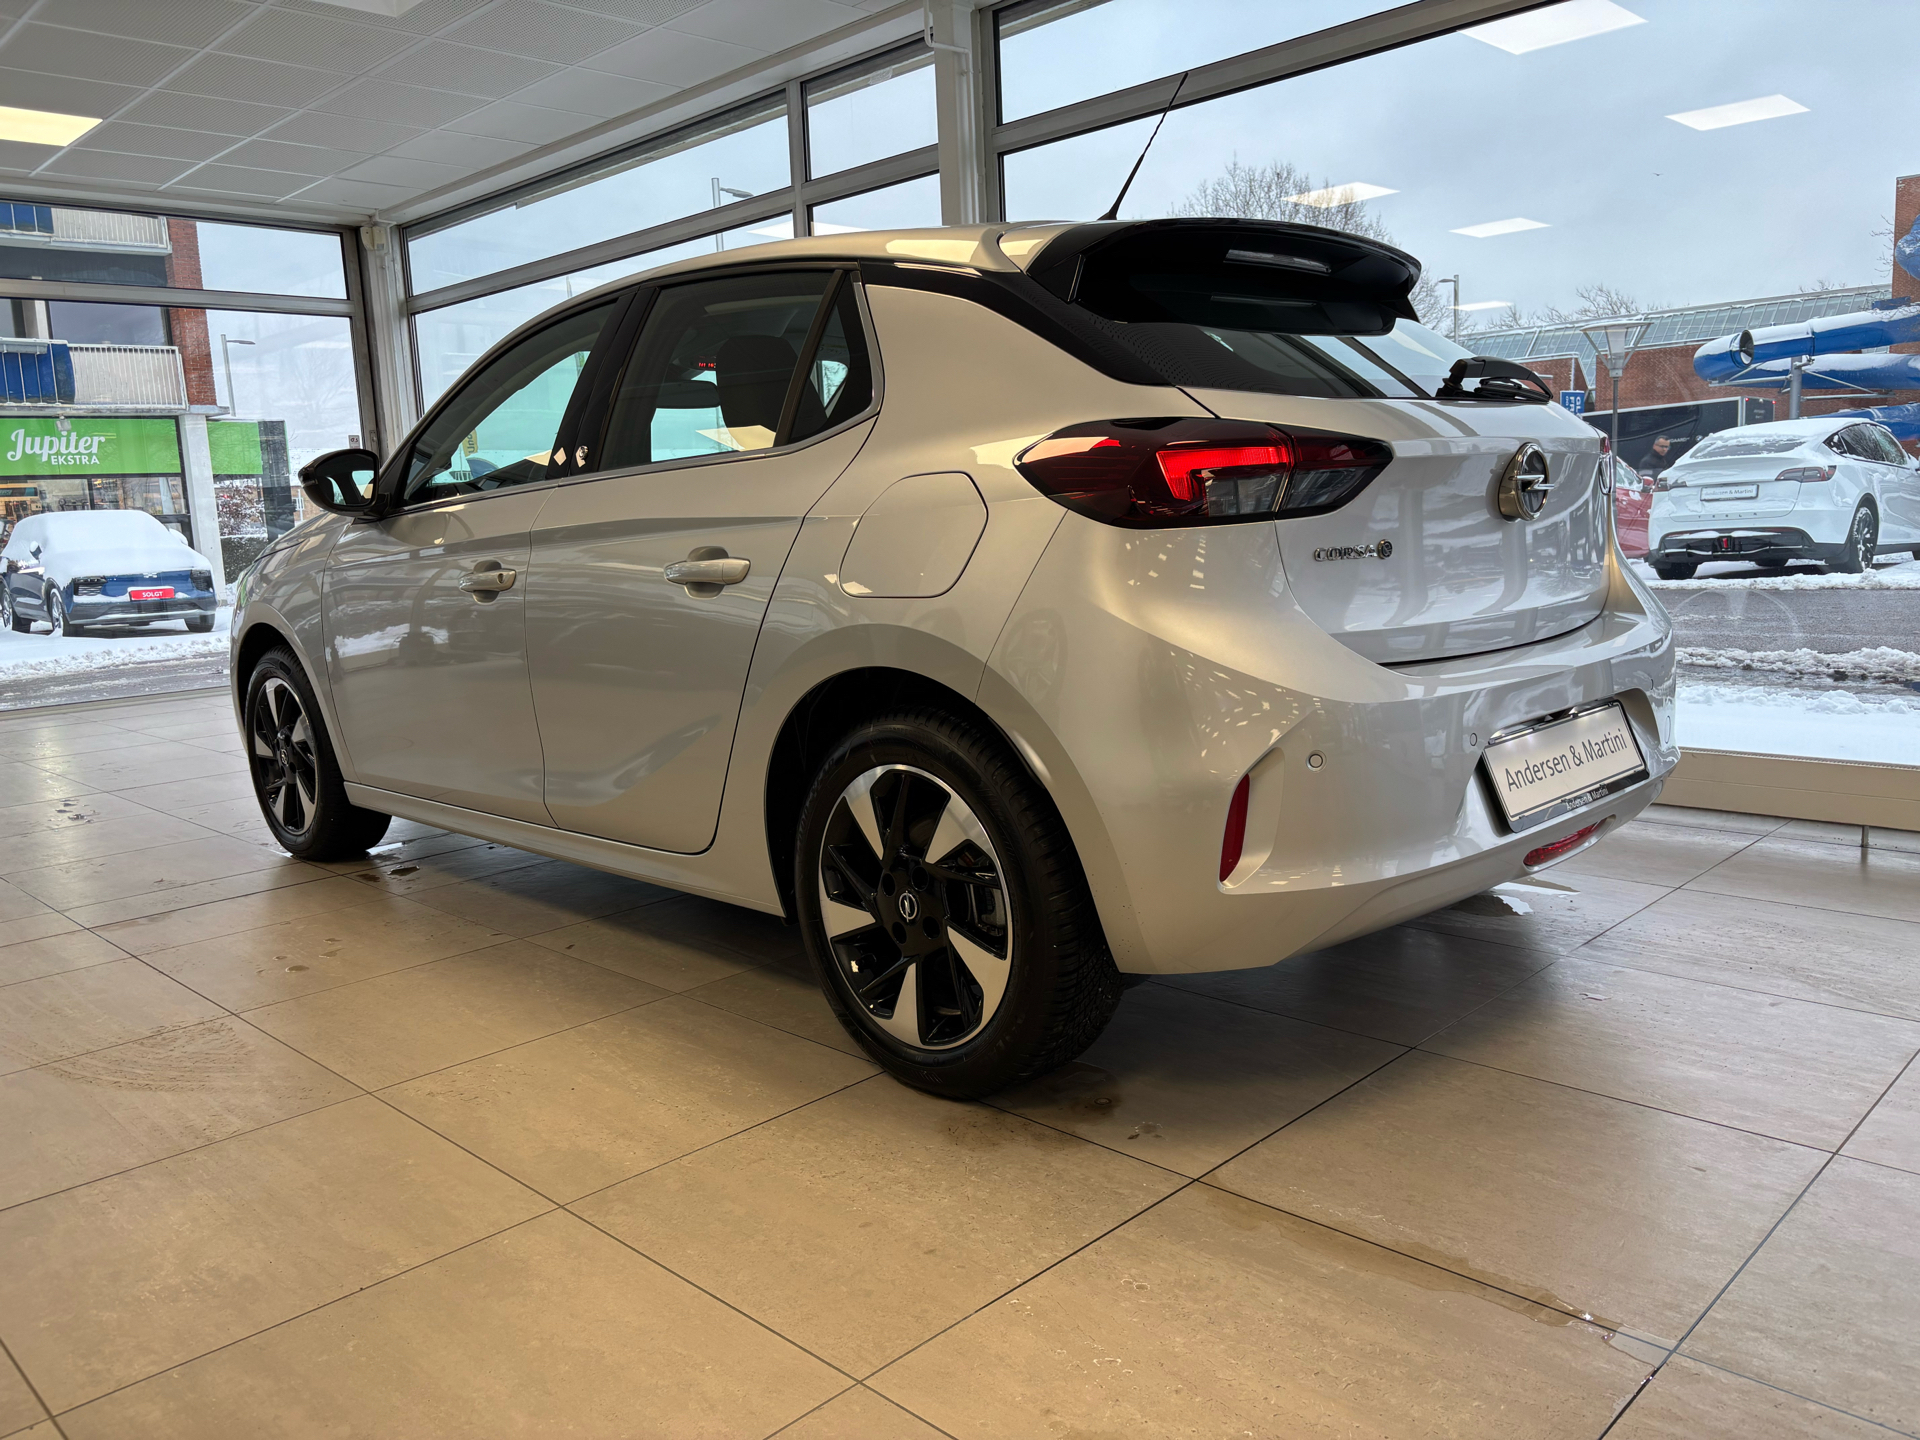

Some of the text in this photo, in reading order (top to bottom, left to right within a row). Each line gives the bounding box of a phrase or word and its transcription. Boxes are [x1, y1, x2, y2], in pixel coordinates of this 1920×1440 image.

[7, 429, 105, 462] Jupiter
[51, 455, 100, 465] EKSTRA
[1314, 545, 1377, 562] CORSA
[1505, 728, 1627, 792] Andersen & Martini
[1566, 796, 1588, 811] Andersen
[1591, 788, 1609, 799] Martini
